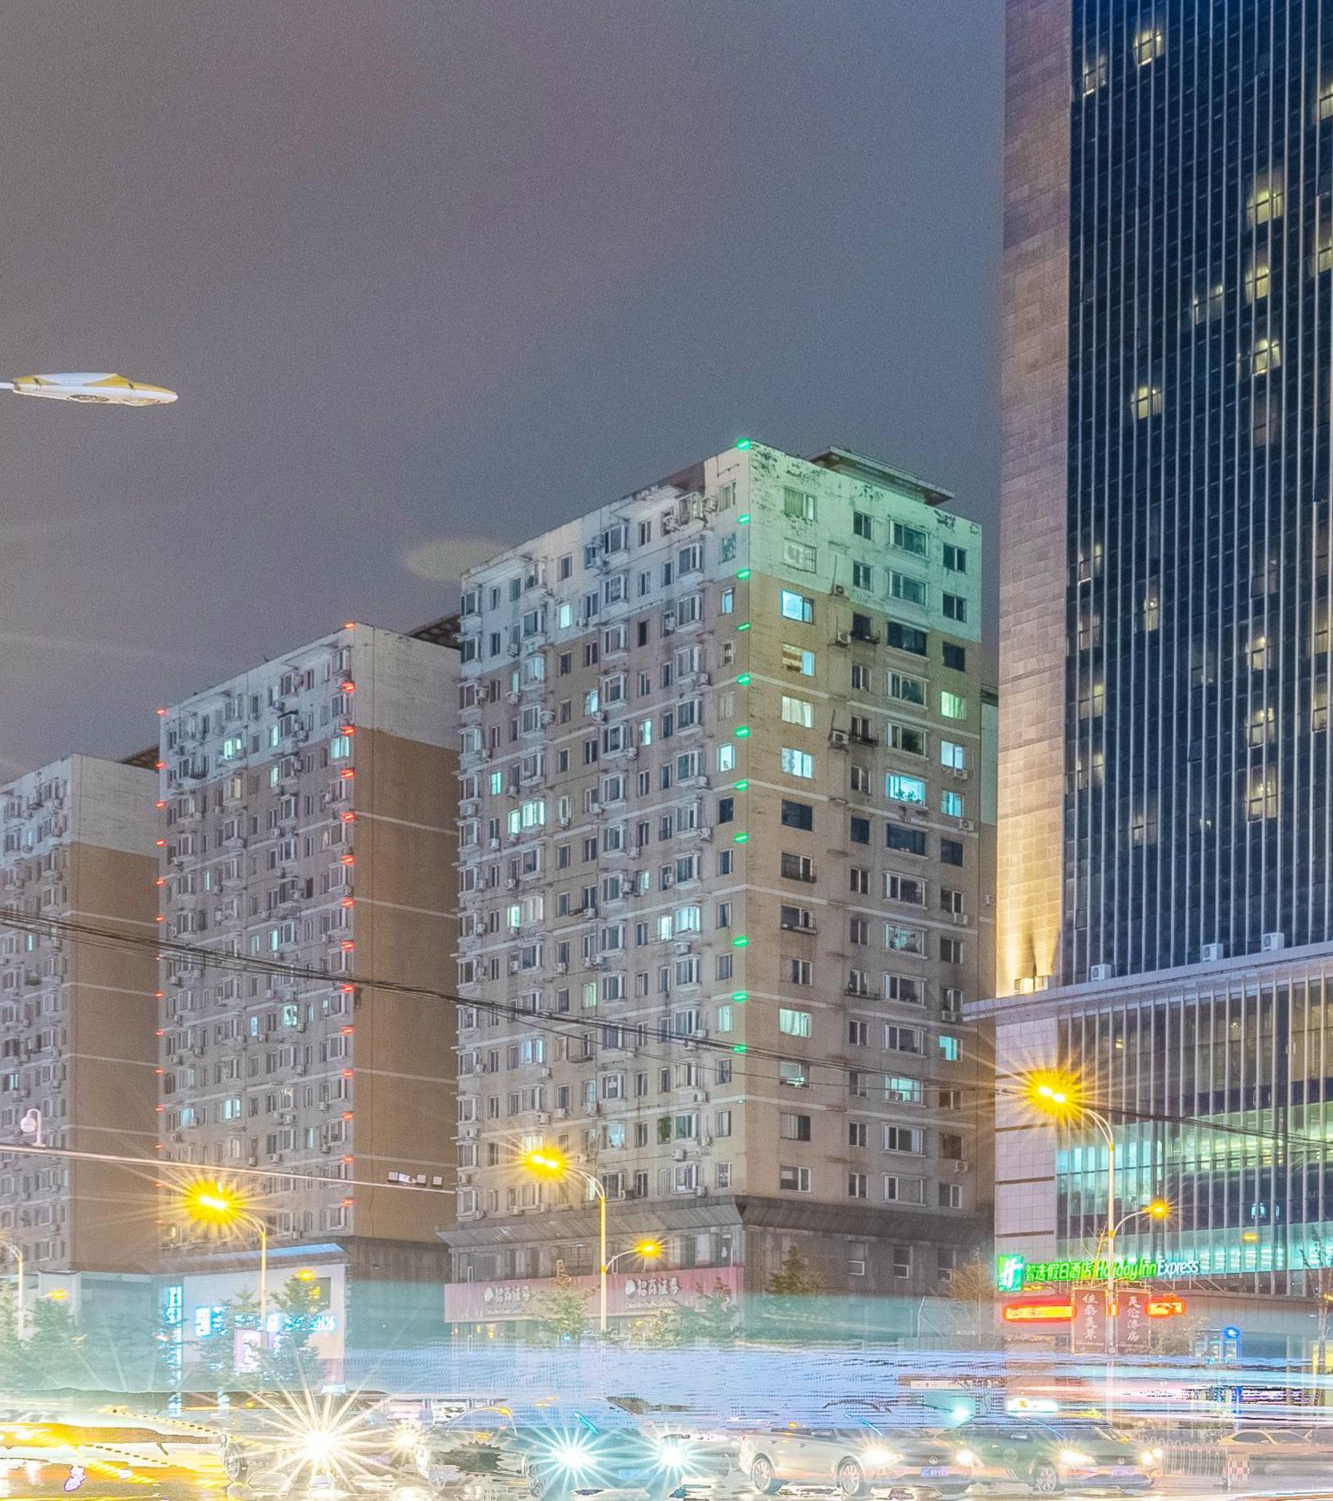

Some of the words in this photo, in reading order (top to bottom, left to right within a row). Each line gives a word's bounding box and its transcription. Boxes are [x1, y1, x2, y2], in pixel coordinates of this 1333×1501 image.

[1025, 1262, 1093, 1282] 智选假日酒店
[1096, 1258, 1139, 1281] Hoiday
[1157, 1258, 1200, 1278] Express
